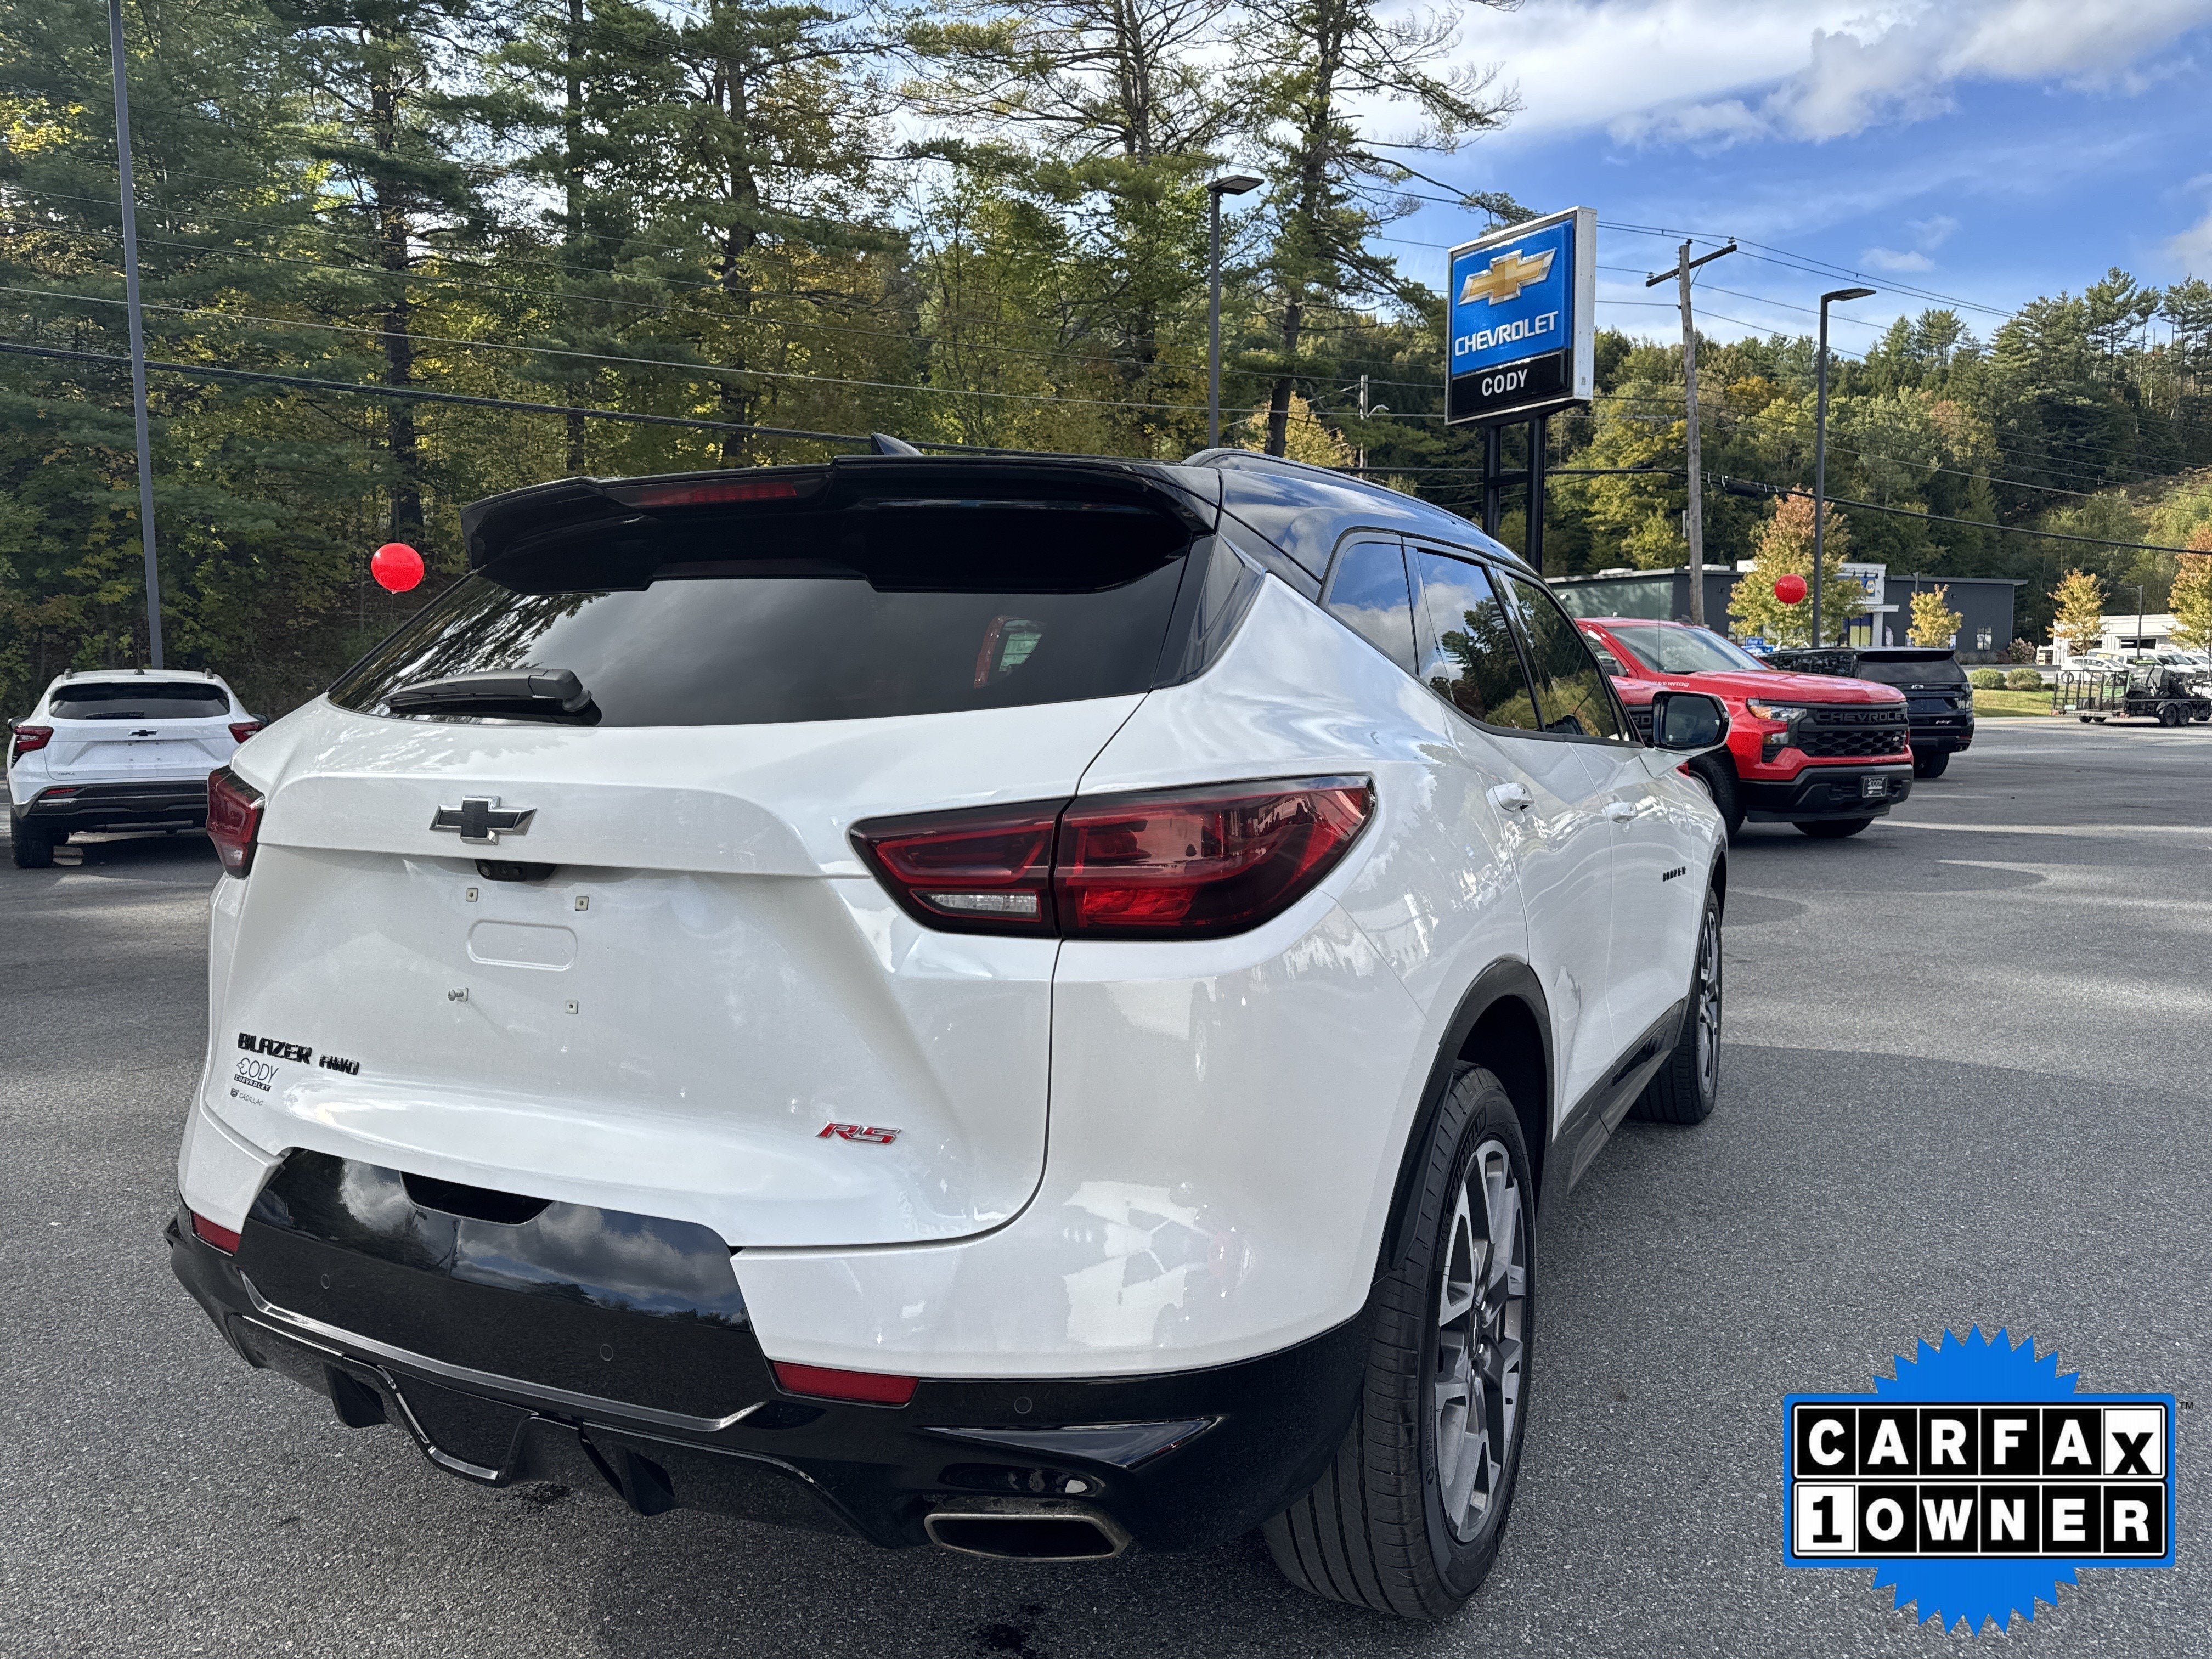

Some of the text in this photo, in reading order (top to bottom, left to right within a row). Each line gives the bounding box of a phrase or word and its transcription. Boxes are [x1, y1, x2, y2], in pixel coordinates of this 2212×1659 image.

[1455, 311, 1559, 356] CHEVROLET
[1482, 368, 1528, 396] CODY
[1816, 712, 1907, 722] CHEVROLET
[238, 1032, 360, 1075] BLAZER AWD
[235, 1075, 270, 1091] CHEVROLET
[236, 1057, 279, 1084] CODY
[239, 1093, 264, 1106] CADILLAC
[815, 1121, 902, 1145] RS
